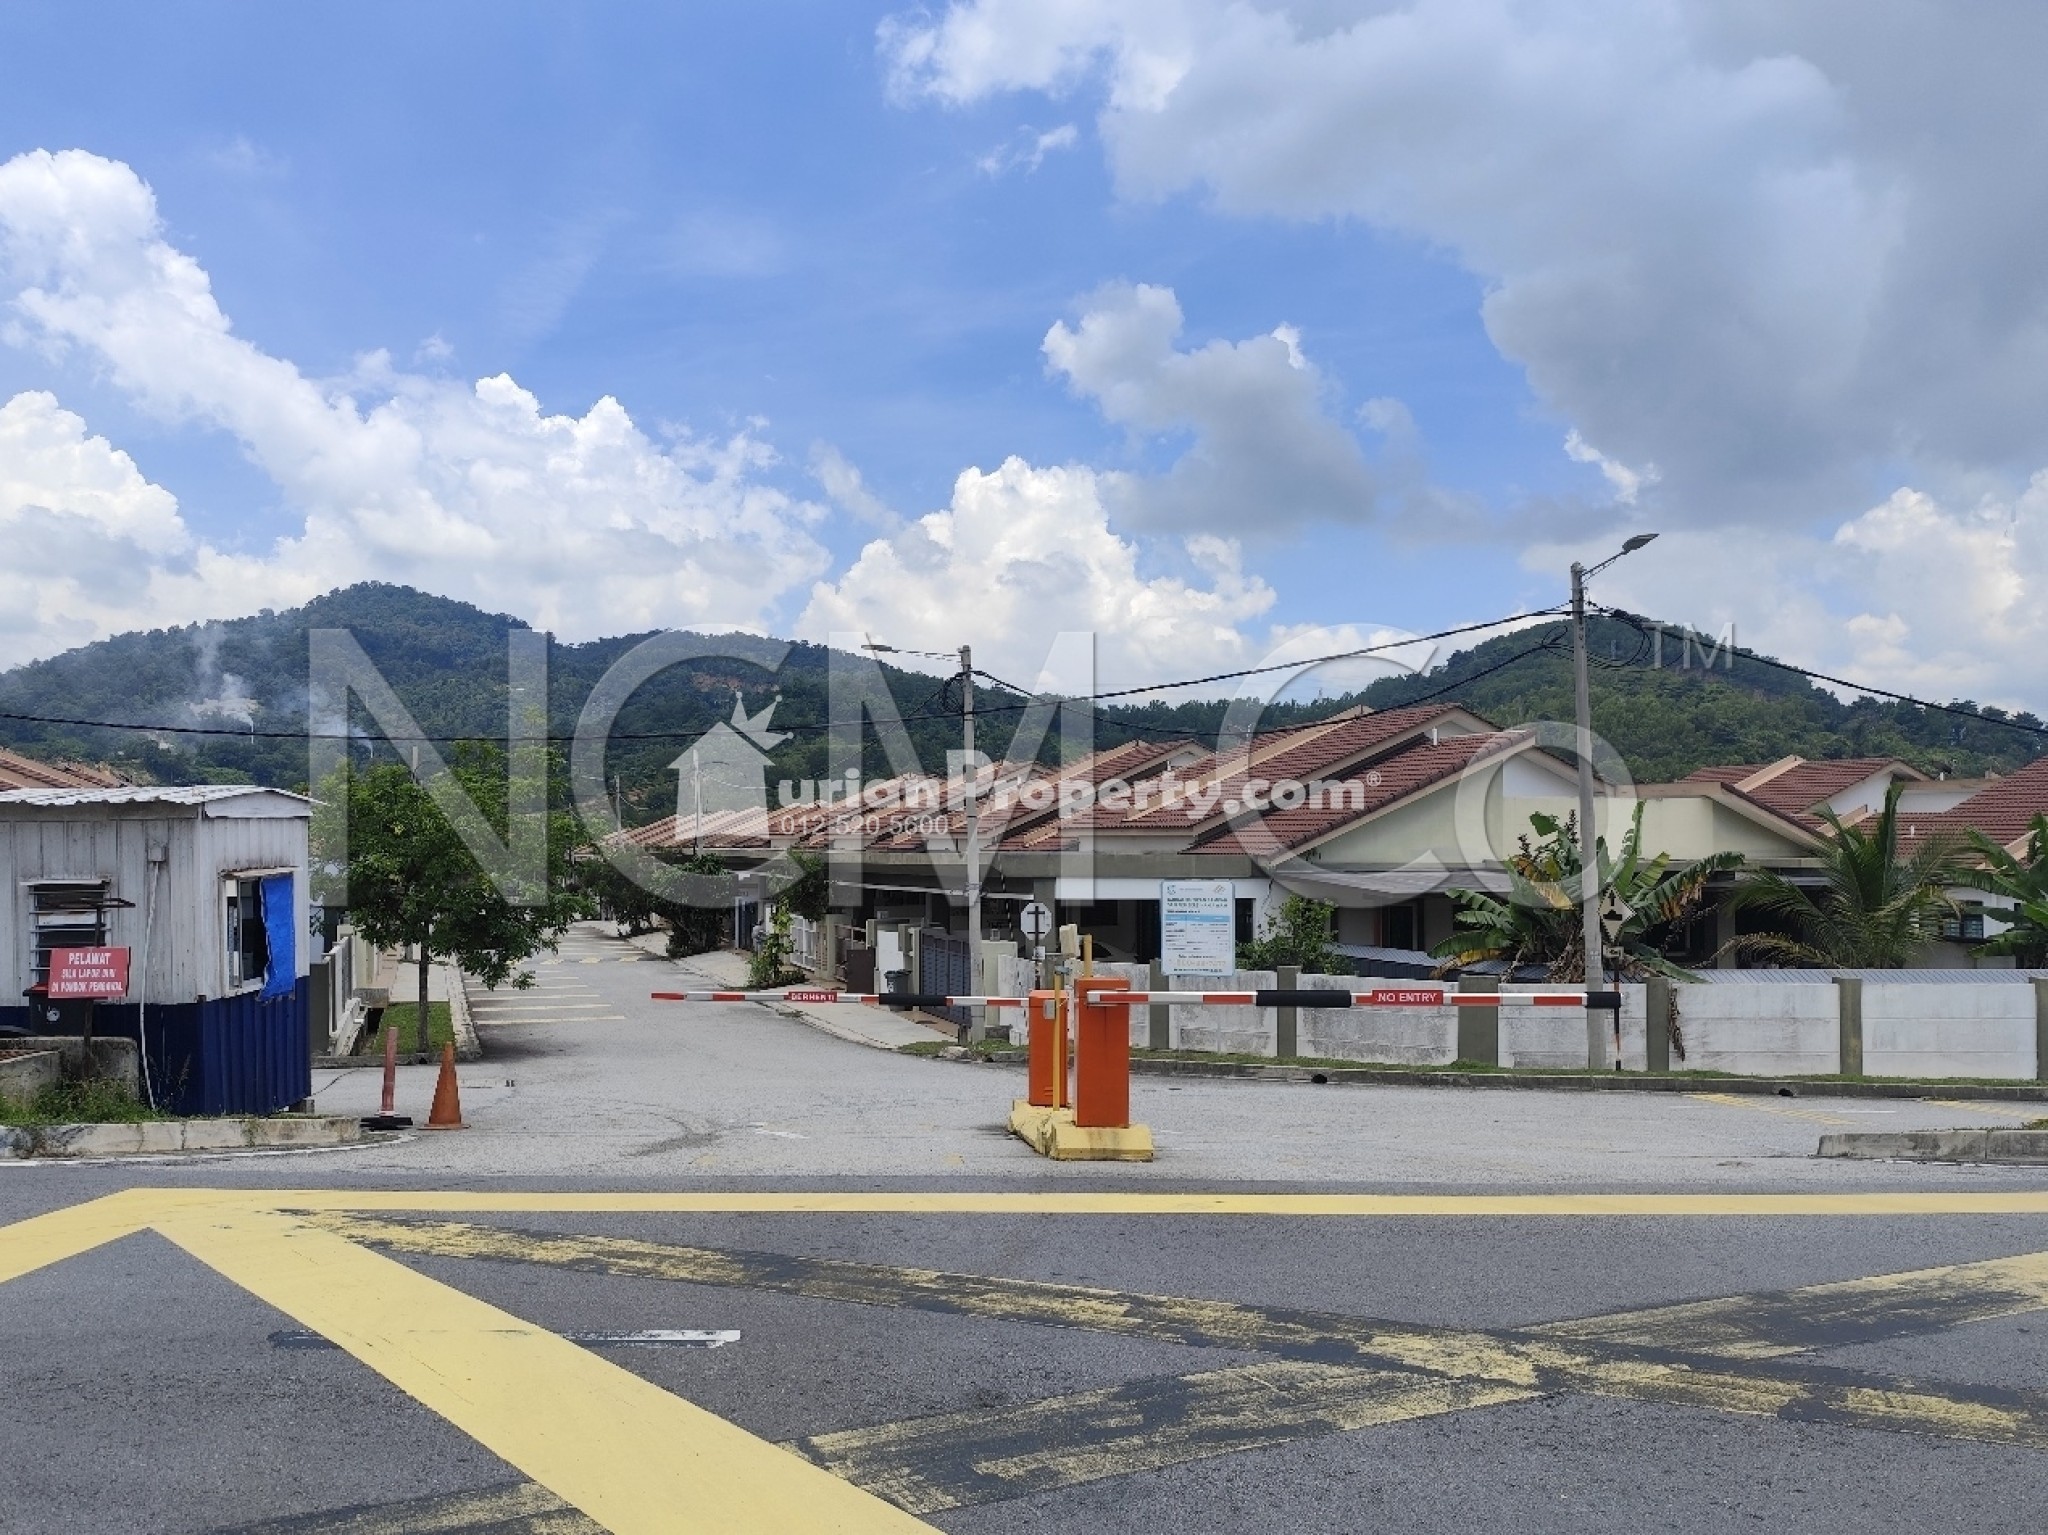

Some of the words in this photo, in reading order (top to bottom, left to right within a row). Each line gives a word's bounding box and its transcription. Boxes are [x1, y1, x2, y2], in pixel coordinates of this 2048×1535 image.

[68, 952, 111, 965] PELAWAT
[791, 992, 834, 1001] BERHENTI
[1377, 992, 1396, 1002] NO
[1399, 992, 1437, 1002] ENTRY
